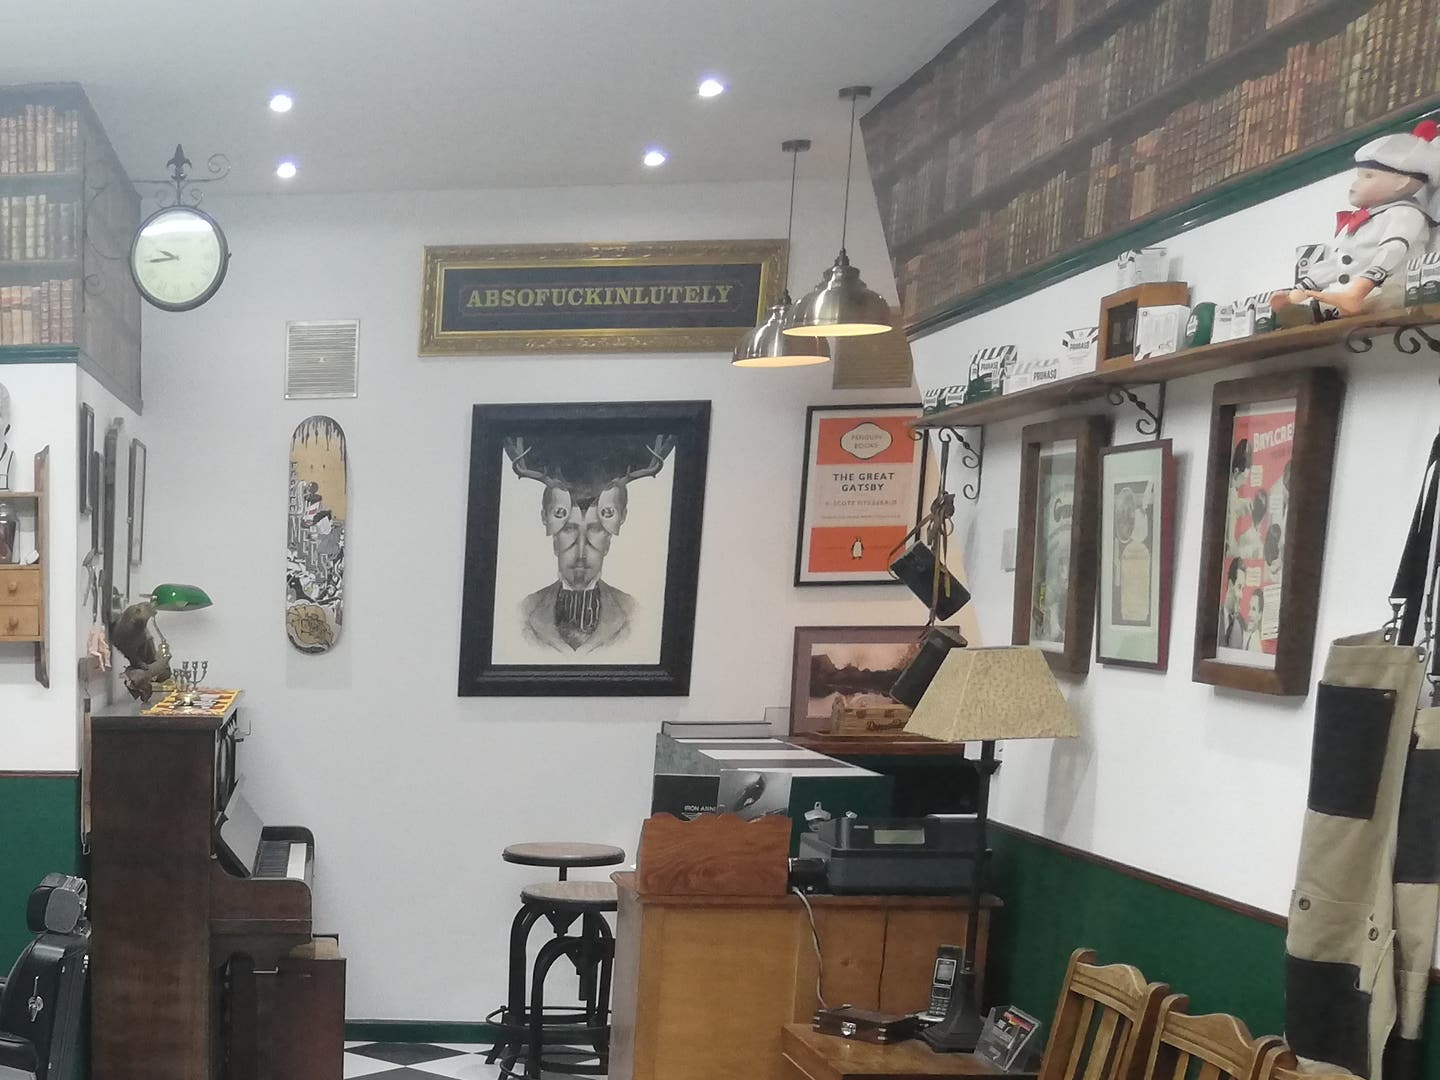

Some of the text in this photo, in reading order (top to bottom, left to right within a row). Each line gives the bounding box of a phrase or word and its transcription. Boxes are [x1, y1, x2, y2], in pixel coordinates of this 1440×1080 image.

[466, 285, 734, 308] ABSOFUCKINLUTELY
[1033, 368, 1057, 382] PRORASO
[833, 472, 895, 481] THE GREAT
[841, 483, 885, 492] GATSBY
